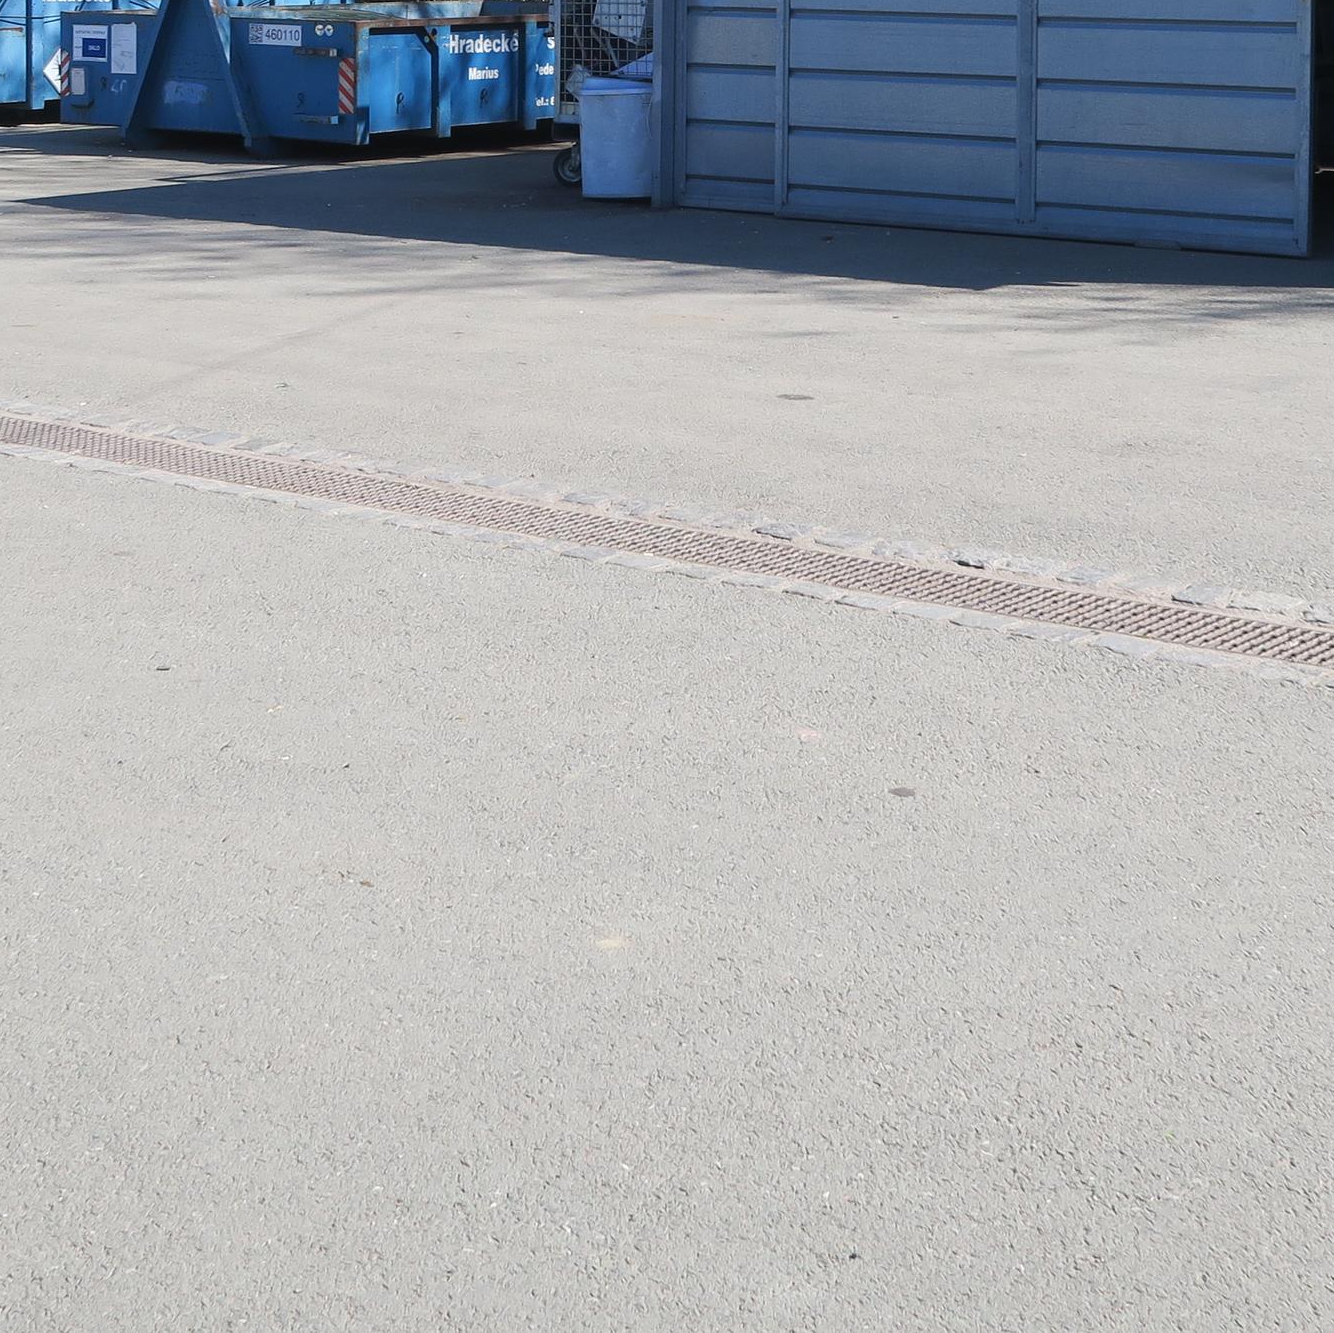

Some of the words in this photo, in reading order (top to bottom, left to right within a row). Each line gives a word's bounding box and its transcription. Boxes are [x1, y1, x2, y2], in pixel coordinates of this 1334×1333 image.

[264, 28, 300, 42] 460110
[449, 32, 519, 54] Hradecké
[468, 66, 499, 81] Marius
